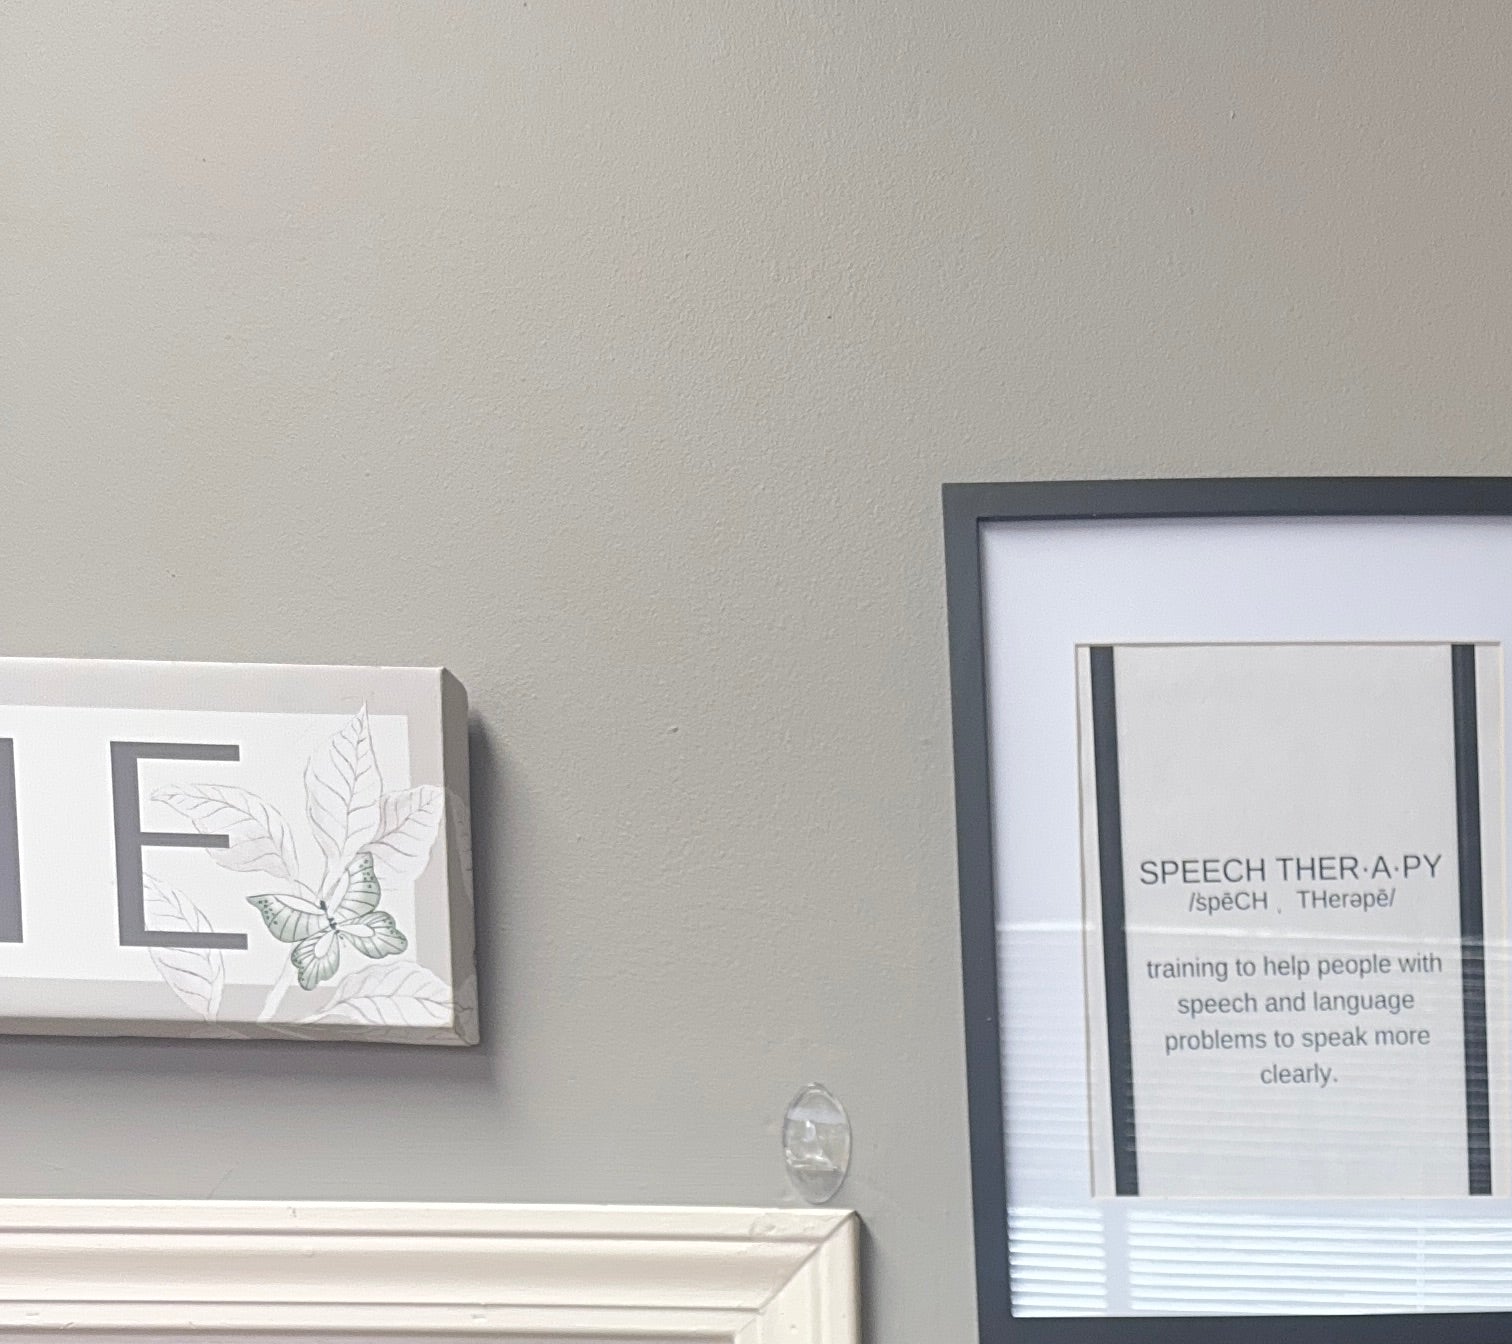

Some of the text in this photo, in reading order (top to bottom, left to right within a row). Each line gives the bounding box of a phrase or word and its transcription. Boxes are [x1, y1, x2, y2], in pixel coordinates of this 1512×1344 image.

[0, 738, 248, 950] E
[1140, 857, 1266, 885] SPEECH
[1146, 952, 1443, 983] training to help people with
[1177, 991, 1415, 1019] speech and language
[1165, 1026, 1431, 1056] problems to speak more
[1260, 1062, 1339, 1089] clearly.
